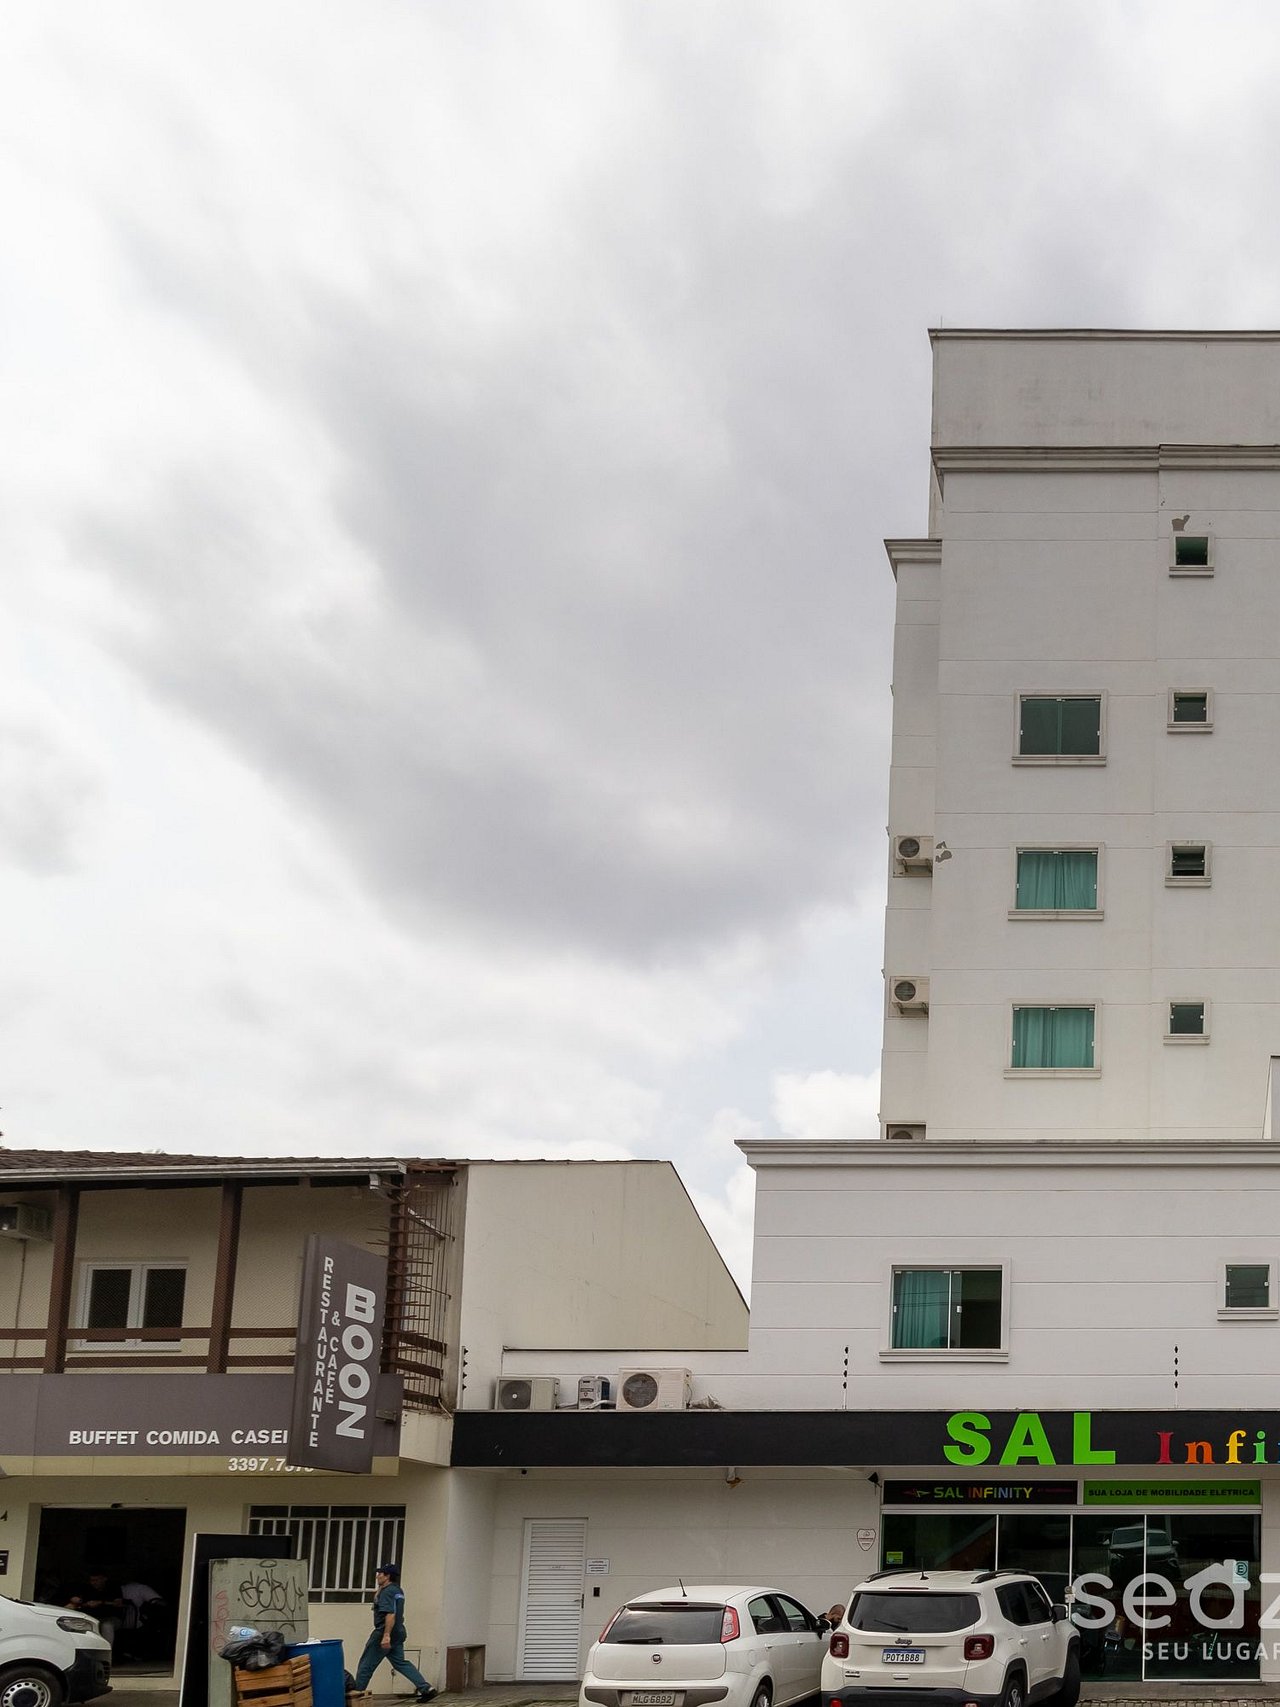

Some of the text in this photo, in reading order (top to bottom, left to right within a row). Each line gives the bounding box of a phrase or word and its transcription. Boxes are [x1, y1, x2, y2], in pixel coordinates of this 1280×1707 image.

[308, 1256, 334, 1448] RESTAURANTE
[325, 1311, 341, 1404] & CAFÉ
[335, 1283, 376, 1439] BOOZ
[69, 1430, 138, 1445] BUFFET
[146, 1430, 220, 1445] COMIDA
[943, 1412, 1116, 1466] SAL
[934, 1487, 963, 1498] SAL
[968, 1487, 1033, 1499] INFINITY
